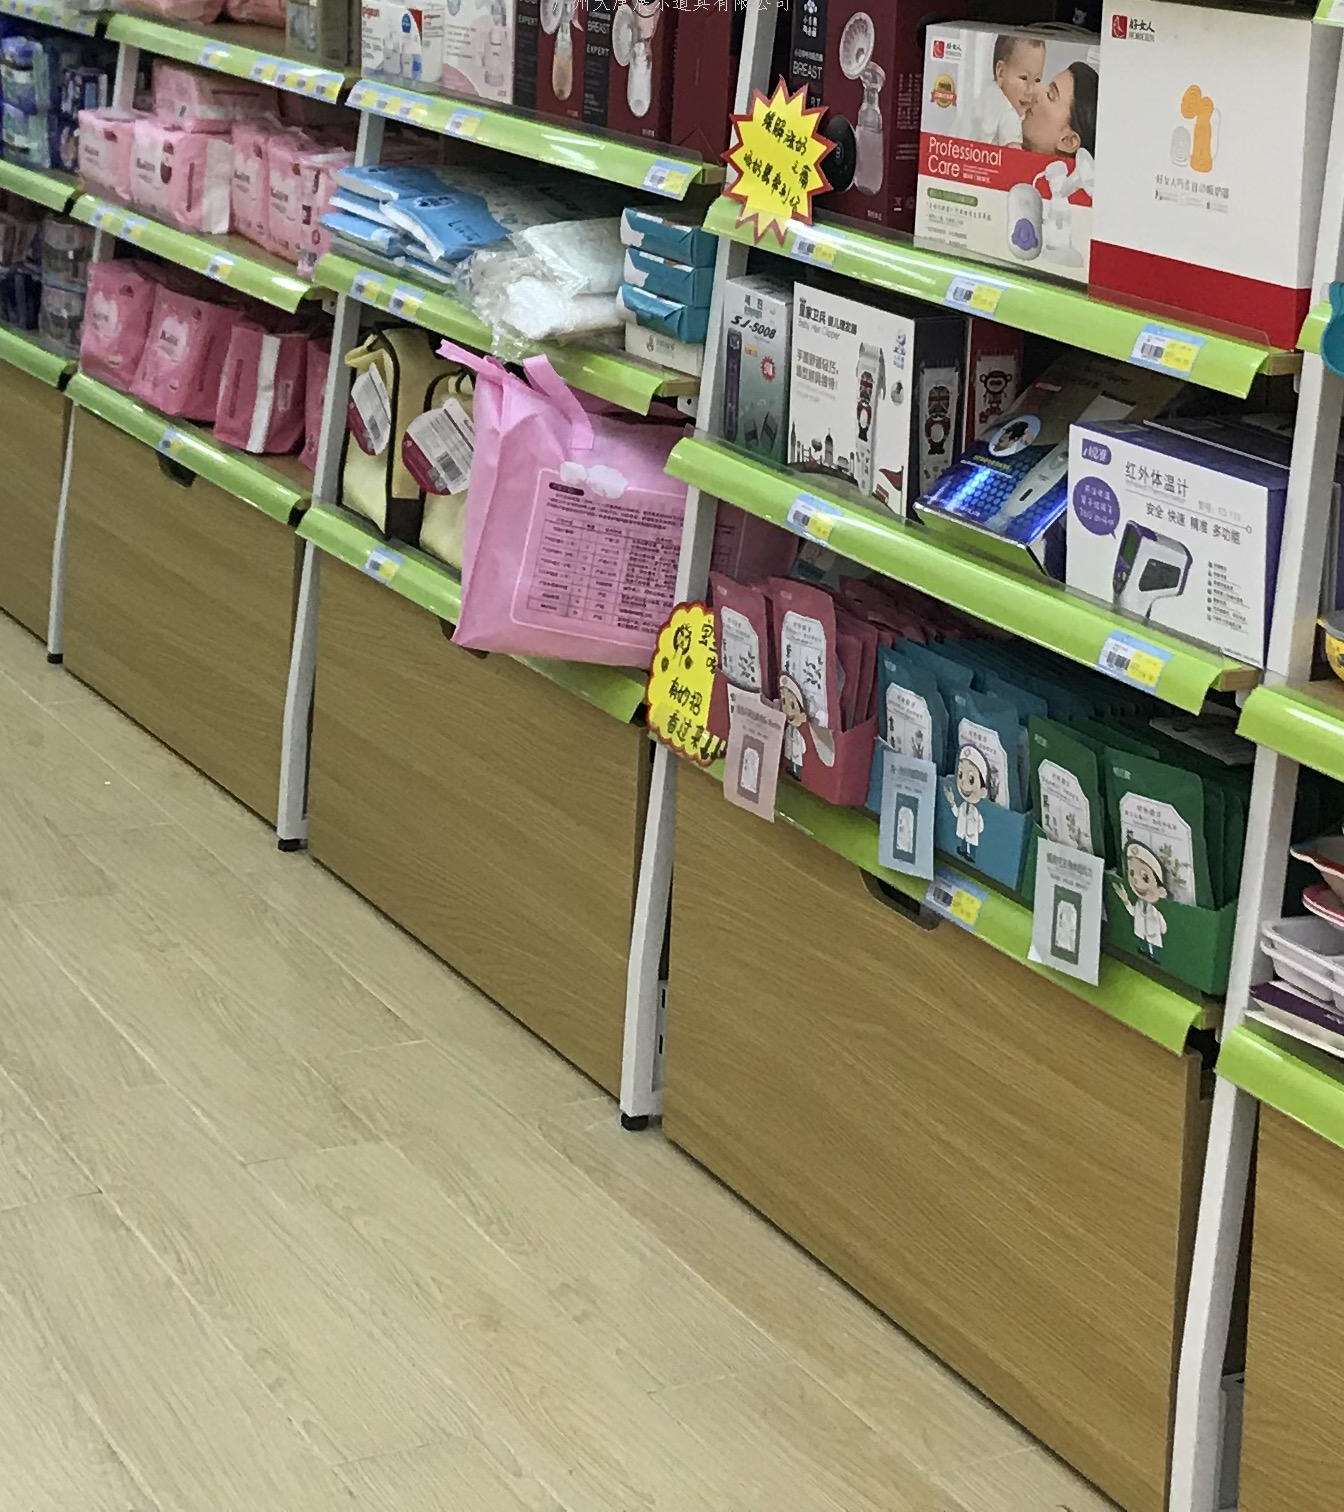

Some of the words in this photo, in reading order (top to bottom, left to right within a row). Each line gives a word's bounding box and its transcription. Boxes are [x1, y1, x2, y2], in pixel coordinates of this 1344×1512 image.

[1129, 17, 1156, 34] 好女人
[792, 60, 823, 80] BREAST
[928, 135, 1003, 167] Professional
[927, 155, 960, 178] Care
[1124, 460, 1190, 498] 红外体温计
[1145, 501, 1165, 520] 安全
[1167, 509, 1186, 528] 快速
[1189, 514, 1209, 534] 精准
[1211, 522, 1242, 546] 多功能
